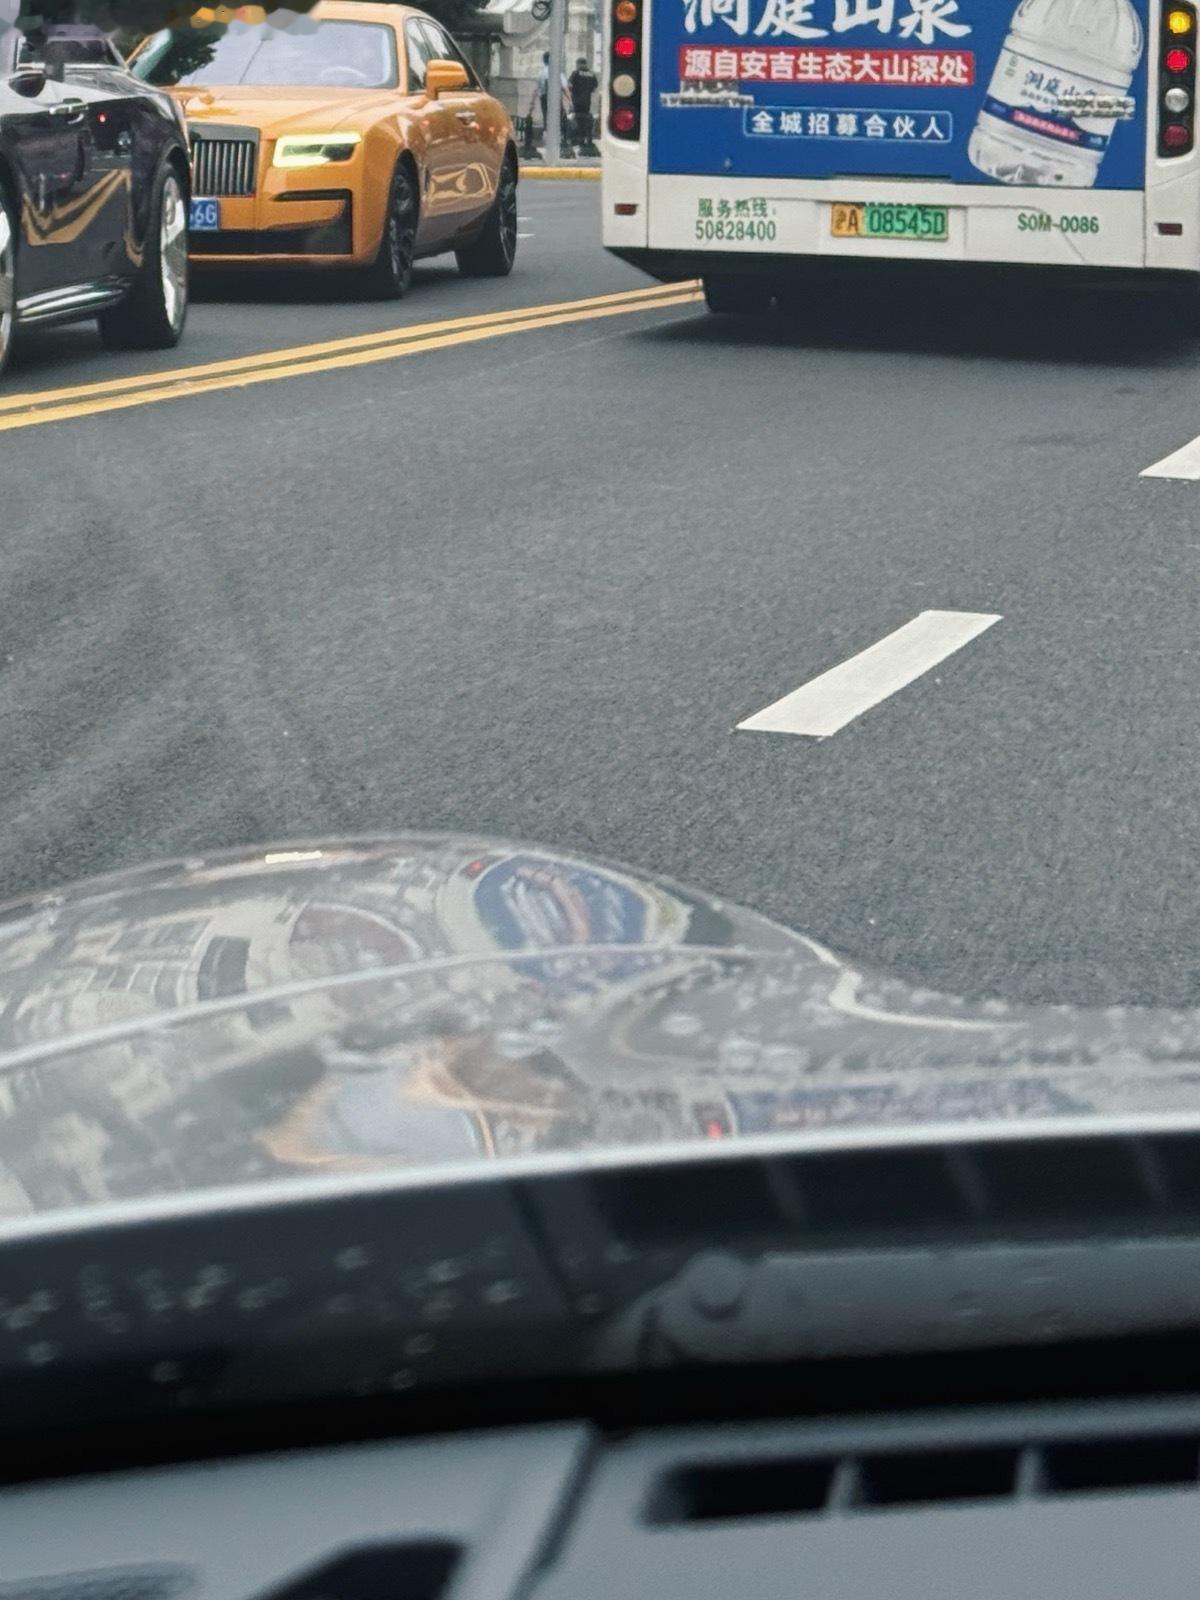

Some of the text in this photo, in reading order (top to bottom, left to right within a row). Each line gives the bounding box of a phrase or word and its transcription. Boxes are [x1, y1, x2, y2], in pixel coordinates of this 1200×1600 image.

[683, 49, 970, 84] 源自安吉生态大山深处
[751, 110, 945, 140] 全城招募合伙人
[695, 219, 777, 241] 50828400
